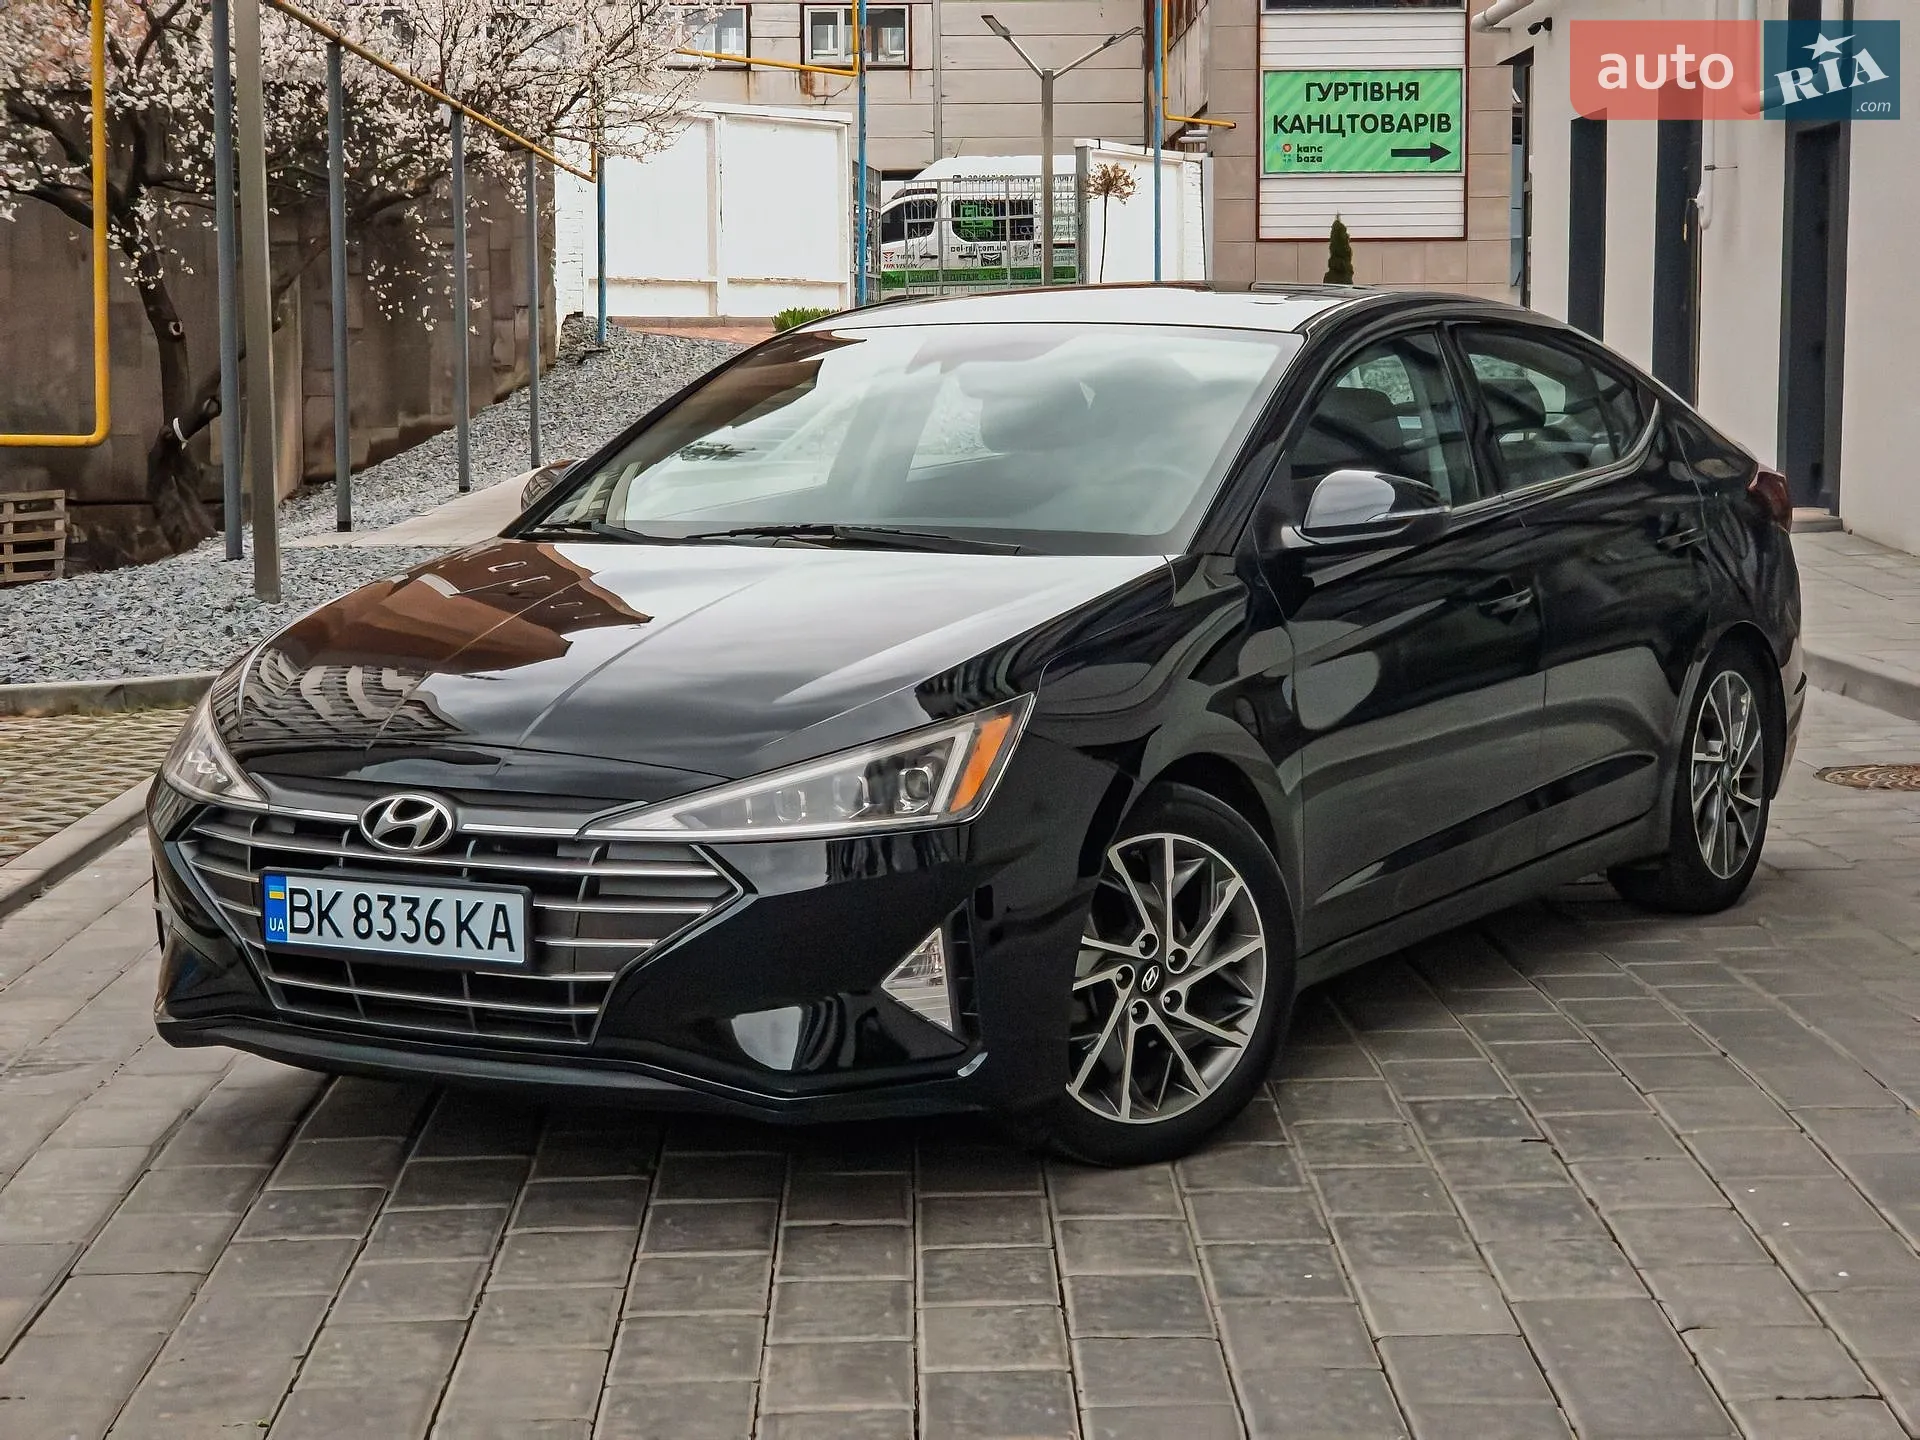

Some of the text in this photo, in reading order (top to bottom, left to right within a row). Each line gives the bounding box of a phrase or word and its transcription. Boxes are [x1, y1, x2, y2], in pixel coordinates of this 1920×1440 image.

[1305, 81, 1420, 102] ГУРТІВНЯ
[1273, 113, 1452, 138] КАНЦТОВАРІВ
[1296, 143, 1323, 153] kanc
[1296, 154, 1323, 163] baza
[269, 917, 285, 933] UA
[289, 886, 516, 953] BK 8336 KA
